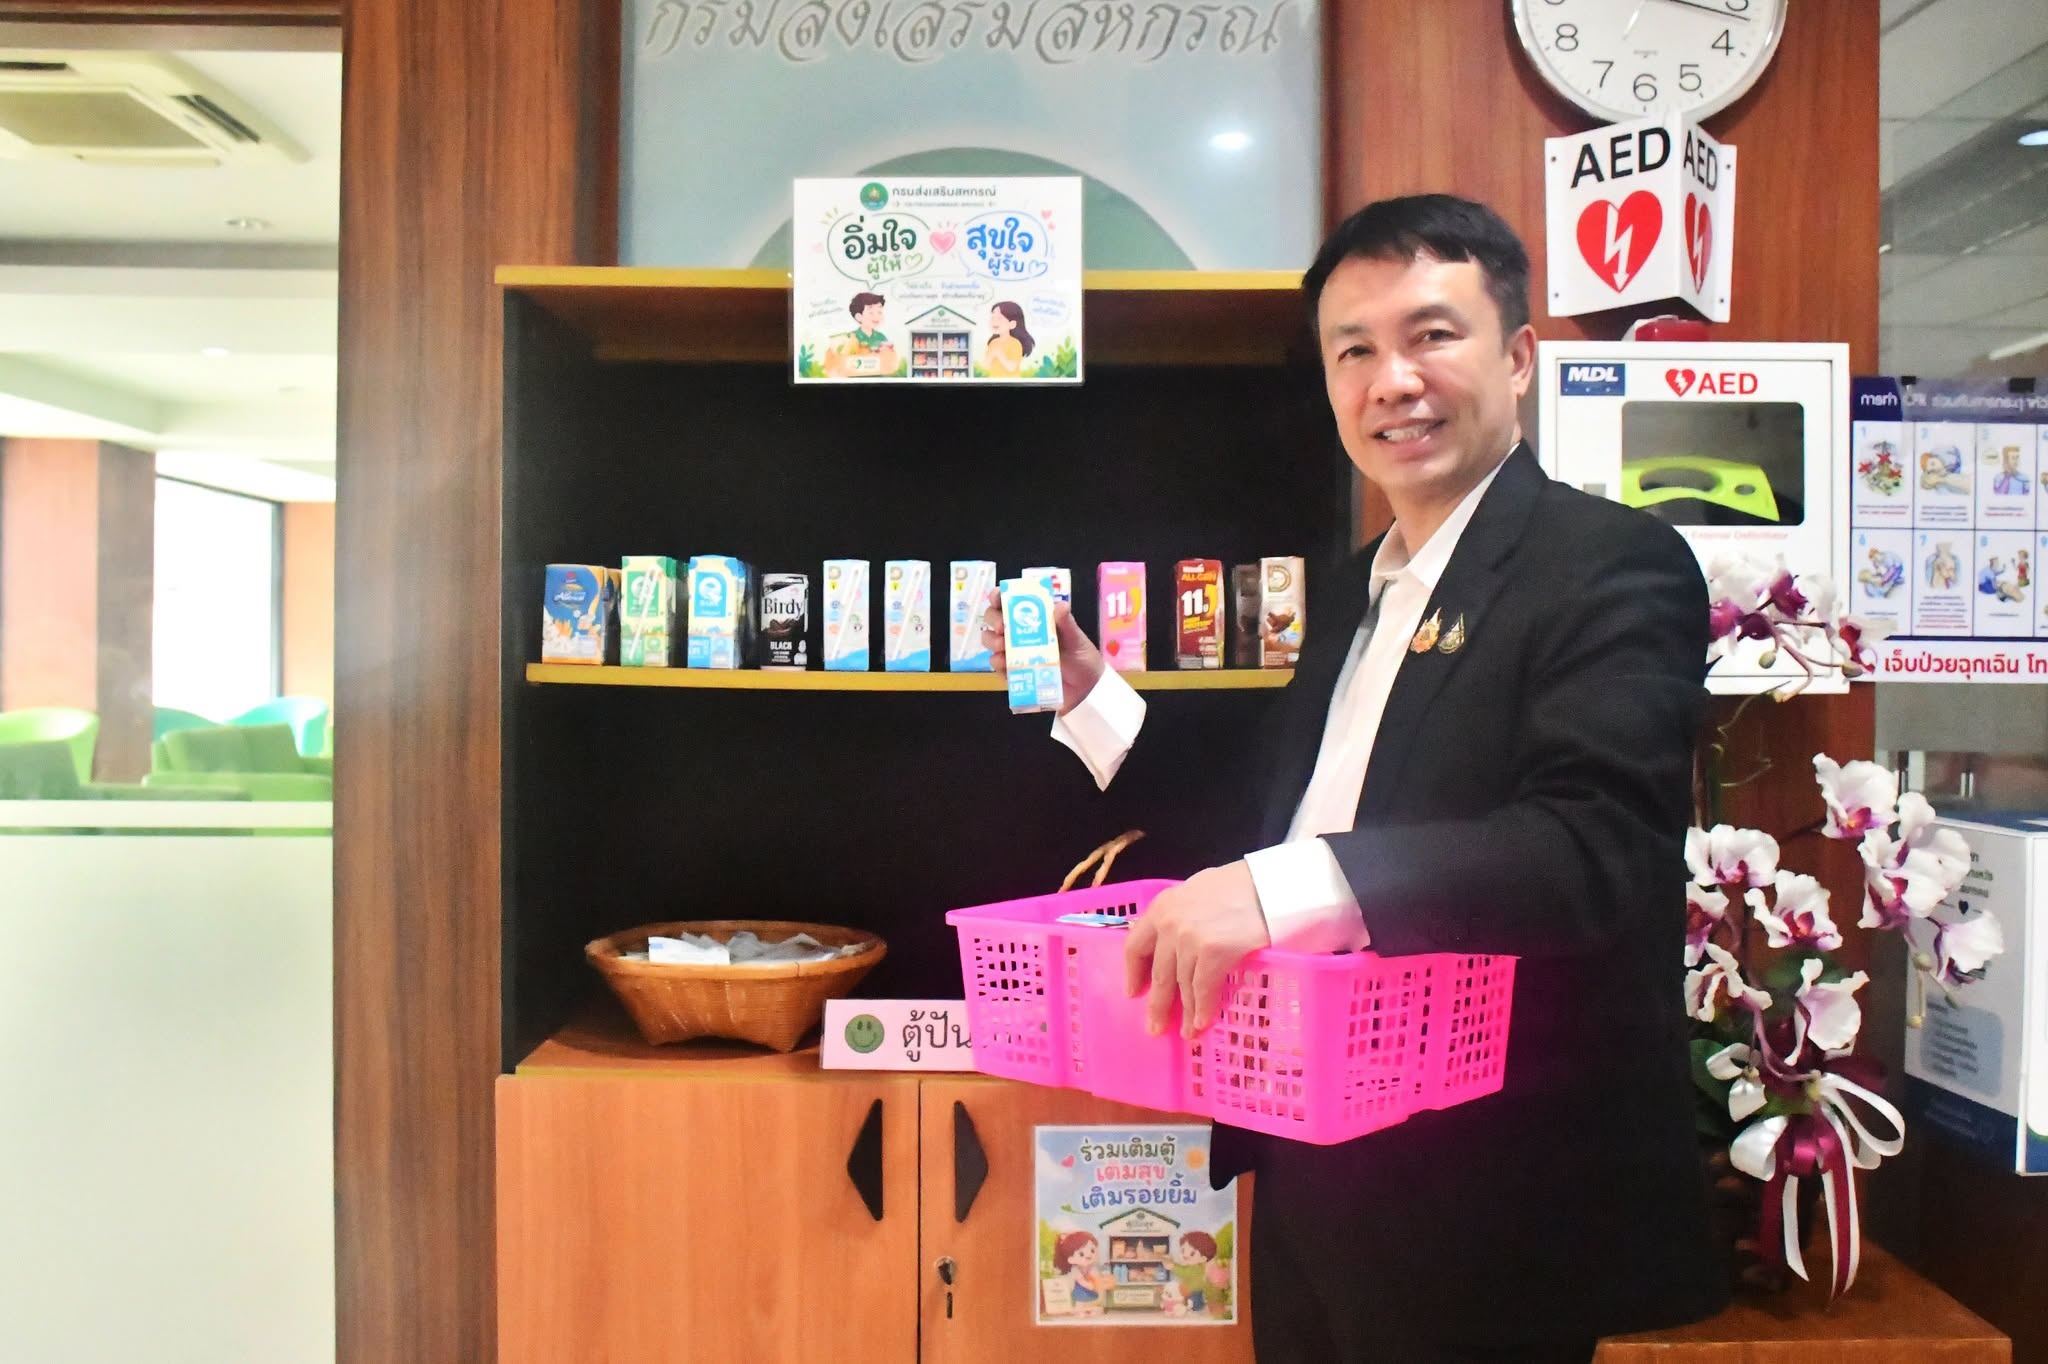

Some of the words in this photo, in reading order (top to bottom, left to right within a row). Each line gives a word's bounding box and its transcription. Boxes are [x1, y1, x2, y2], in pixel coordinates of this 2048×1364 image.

[1555, 24, 1579, 52] 8
[1711, 29, 1734, 56] 4
[1592, 60, 1614, 88] 7
[1633, 73, 1658, 102] 6
[1679, 64, 1702, 92] 5
[1571, 126, 1671, 189] AED
[1683, 129, 1719, 192] AED
[843, 216, 917, 260] อิ่มใจ
[967, 217, 1034, 260] สุขใจ
[867, 254, 902, 280] ผู้ให้
[988, 254, 1025, 277] ผู้รับ
[1568, 366, 1620, 383] MDL
[1697, 372, 1759, 395] AED
[764, 598, 803, 620] Birdy
[1884, 649, 2019, 680] เจ็บป่วยฉุกเฉิน
[1080, 1137, 1176, 1166] ร่วมเติมตู้
[1081, 1173, 1198, 1209] เติมรอยยิ้ม
